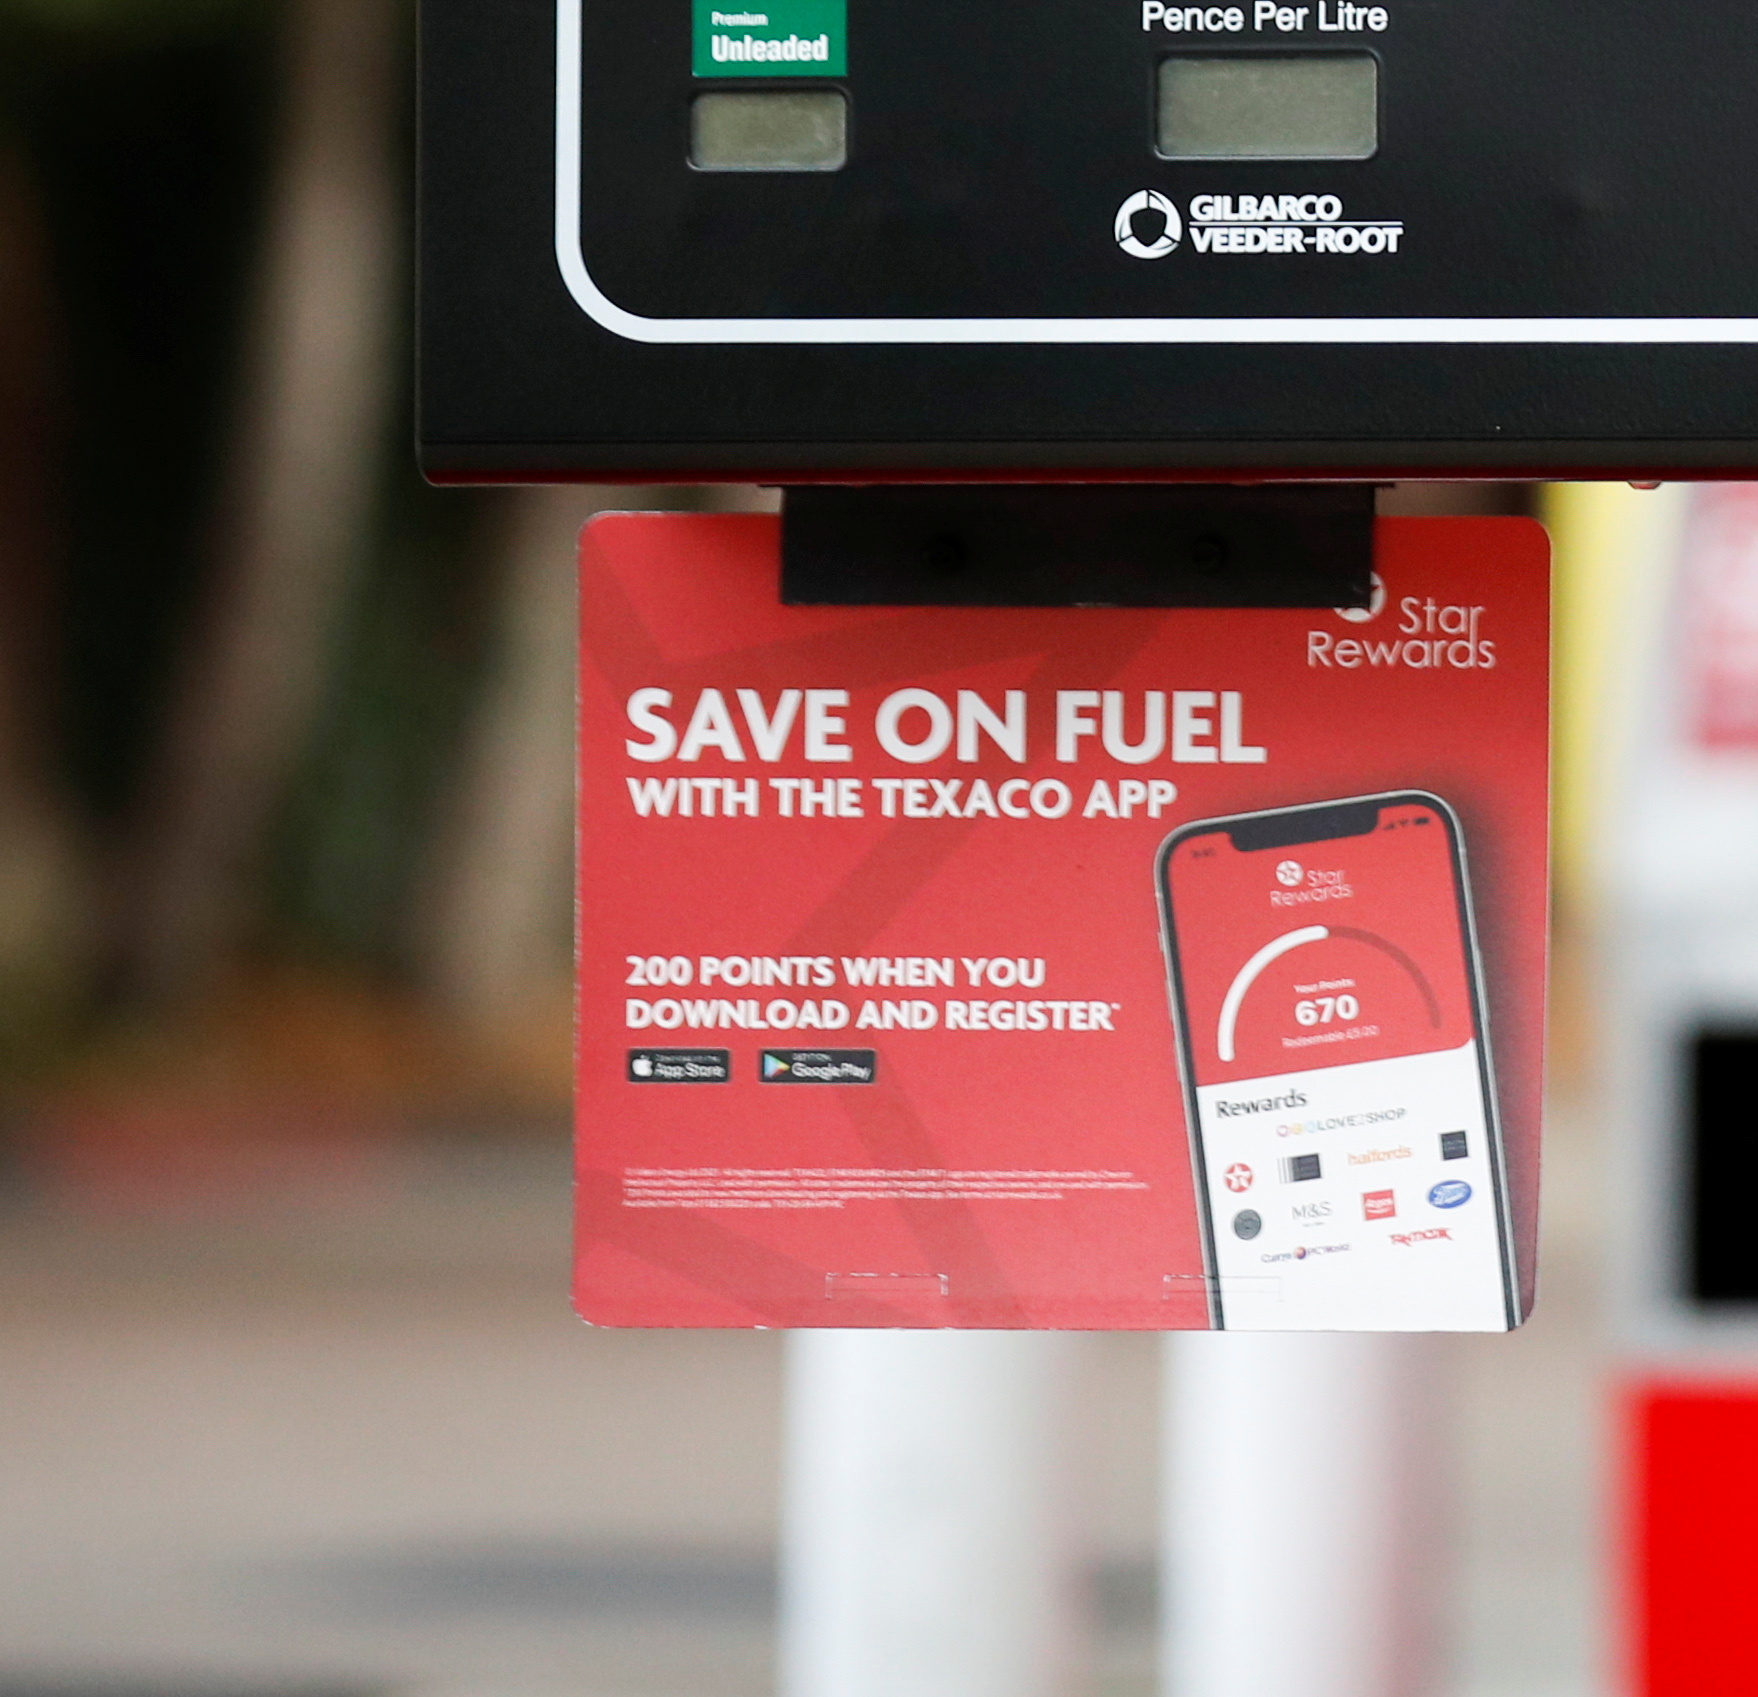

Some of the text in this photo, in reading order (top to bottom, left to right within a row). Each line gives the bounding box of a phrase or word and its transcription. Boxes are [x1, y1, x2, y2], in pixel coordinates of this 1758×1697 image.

[712, 11, 768, 26] Premium
[1143, 0, 1388, 31] Pence Per Litre
[712, 34, 828, 62] Unleaded
[1190, 195, 1342, 221] GILBARCO
[1189, 227, 1403, 253] VEEDER-ROOT
[1398, 596, 1485, 634] Star
[1307, 630, 1497, 668] Rewards
[626, 688, 1267, 764] SAVE ON FUEL
[626, 778, 1177, 818] WITH THE TEXACO APP
[626, 956, 1045, 987] 200 POINTS WHEN YOU
[626, 999, 849, 1029] DOWNLOAD
[856, 1000, 938, 1029] AND
[1294, 994, 1359, 1027] 670
[1215, 1090, 1307, 1118] Rewards
[1291, 1200, 1333, 1221] M&S
